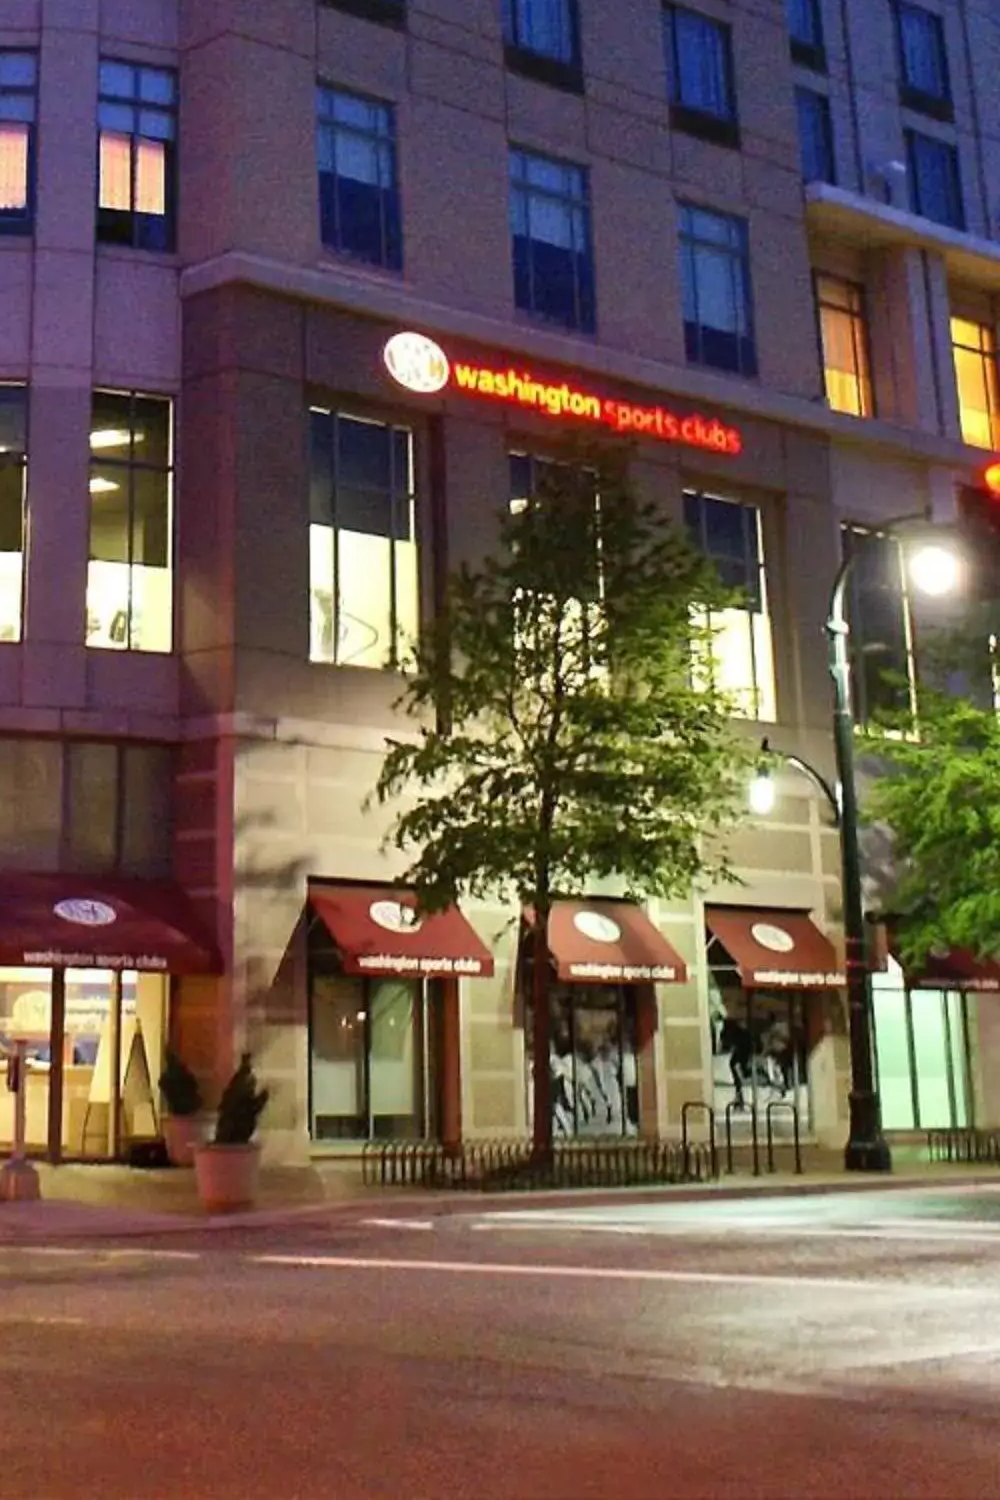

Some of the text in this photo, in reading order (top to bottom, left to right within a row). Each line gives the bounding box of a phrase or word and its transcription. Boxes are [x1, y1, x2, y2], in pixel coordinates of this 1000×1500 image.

[455, 363, 742, 454] washington sports clubs
